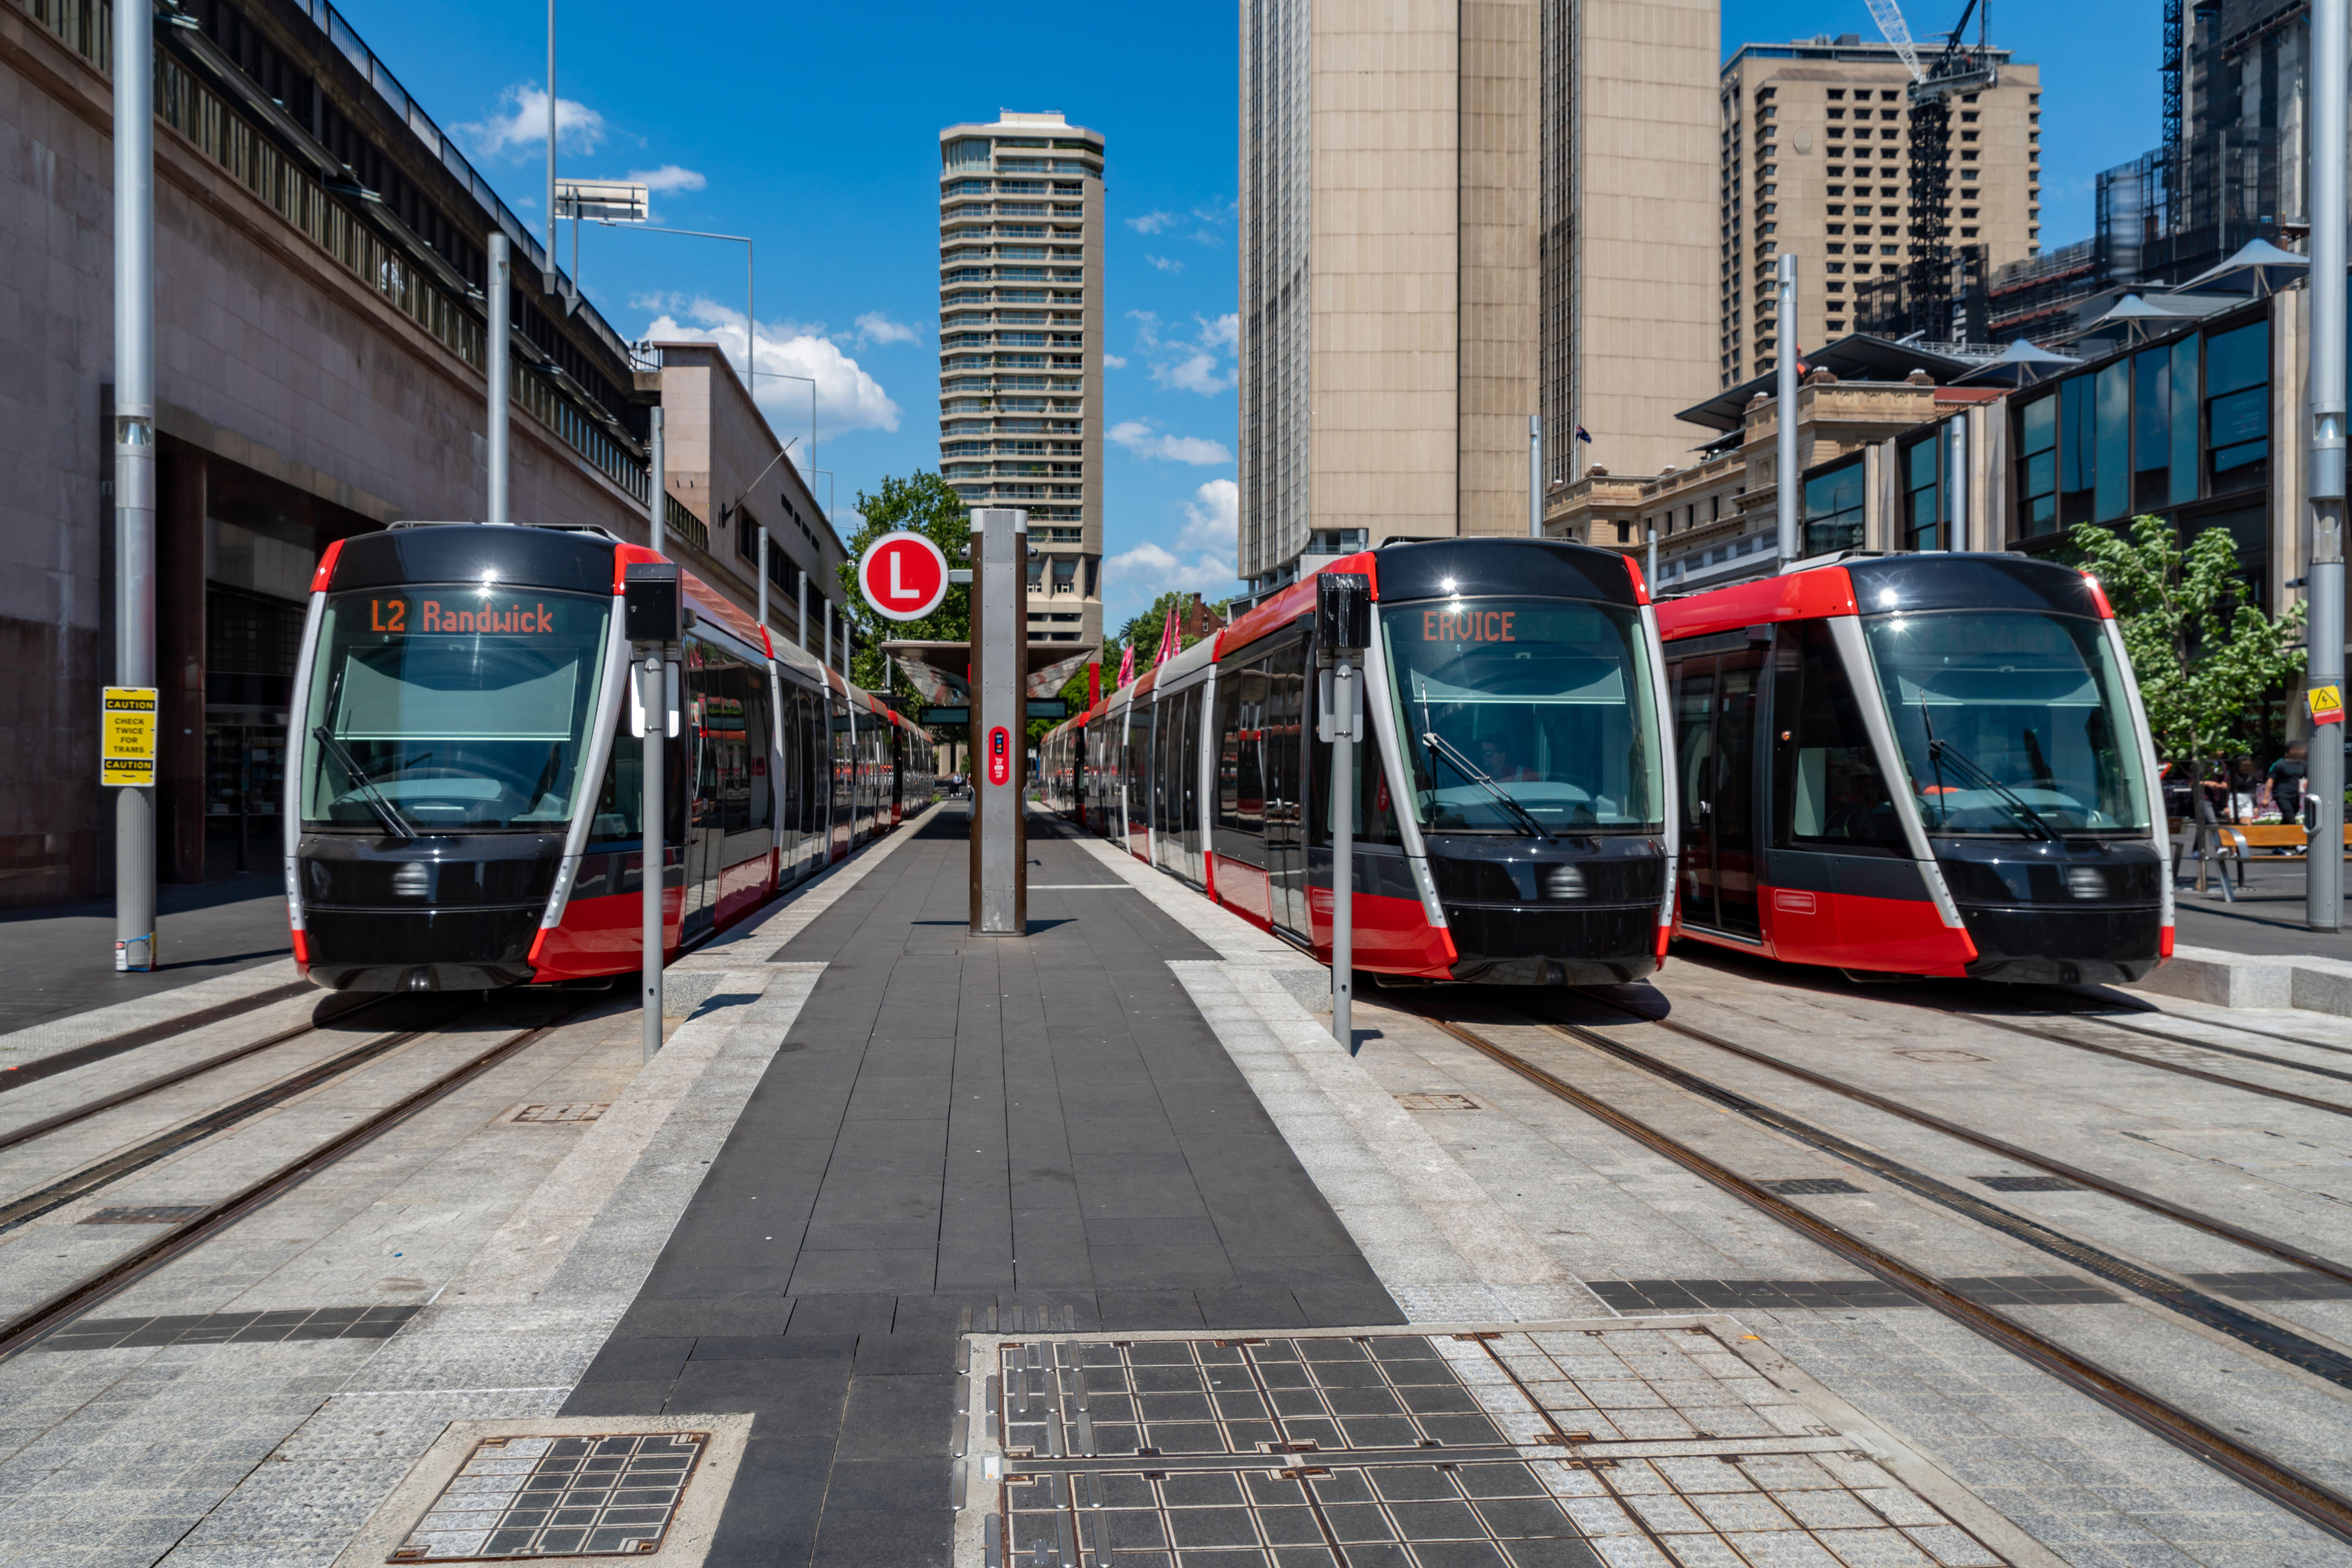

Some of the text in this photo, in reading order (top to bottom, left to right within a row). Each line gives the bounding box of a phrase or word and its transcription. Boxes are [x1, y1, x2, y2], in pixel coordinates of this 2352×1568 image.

[890, 551, 919, 598] L
[372, 600, 552, 633] L2 Randwick
[1423, 611, 1515, 641] ERVICE
[107, 700, 153, 709] CAUTION
[105, 761, 152, 769] CAUTION
